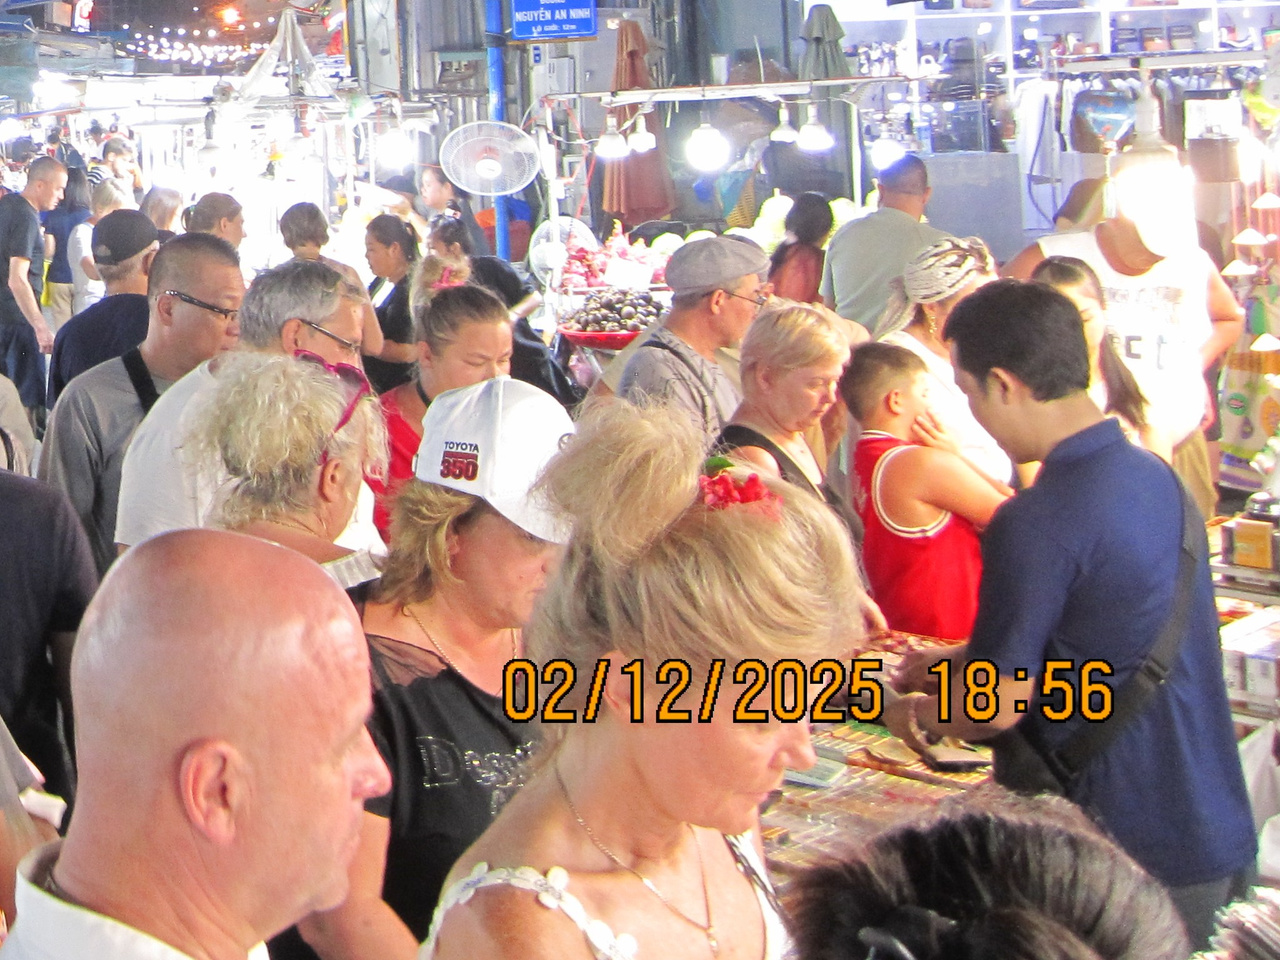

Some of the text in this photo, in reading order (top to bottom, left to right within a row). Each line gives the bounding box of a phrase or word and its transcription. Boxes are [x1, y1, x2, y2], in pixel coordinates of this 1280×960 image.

[554, 8, 567, 20] AN
[569, 8, 591, 20] NINH
[444, 441, 479, 453] TOYOTA
[440, 457, 479, 481] 350
